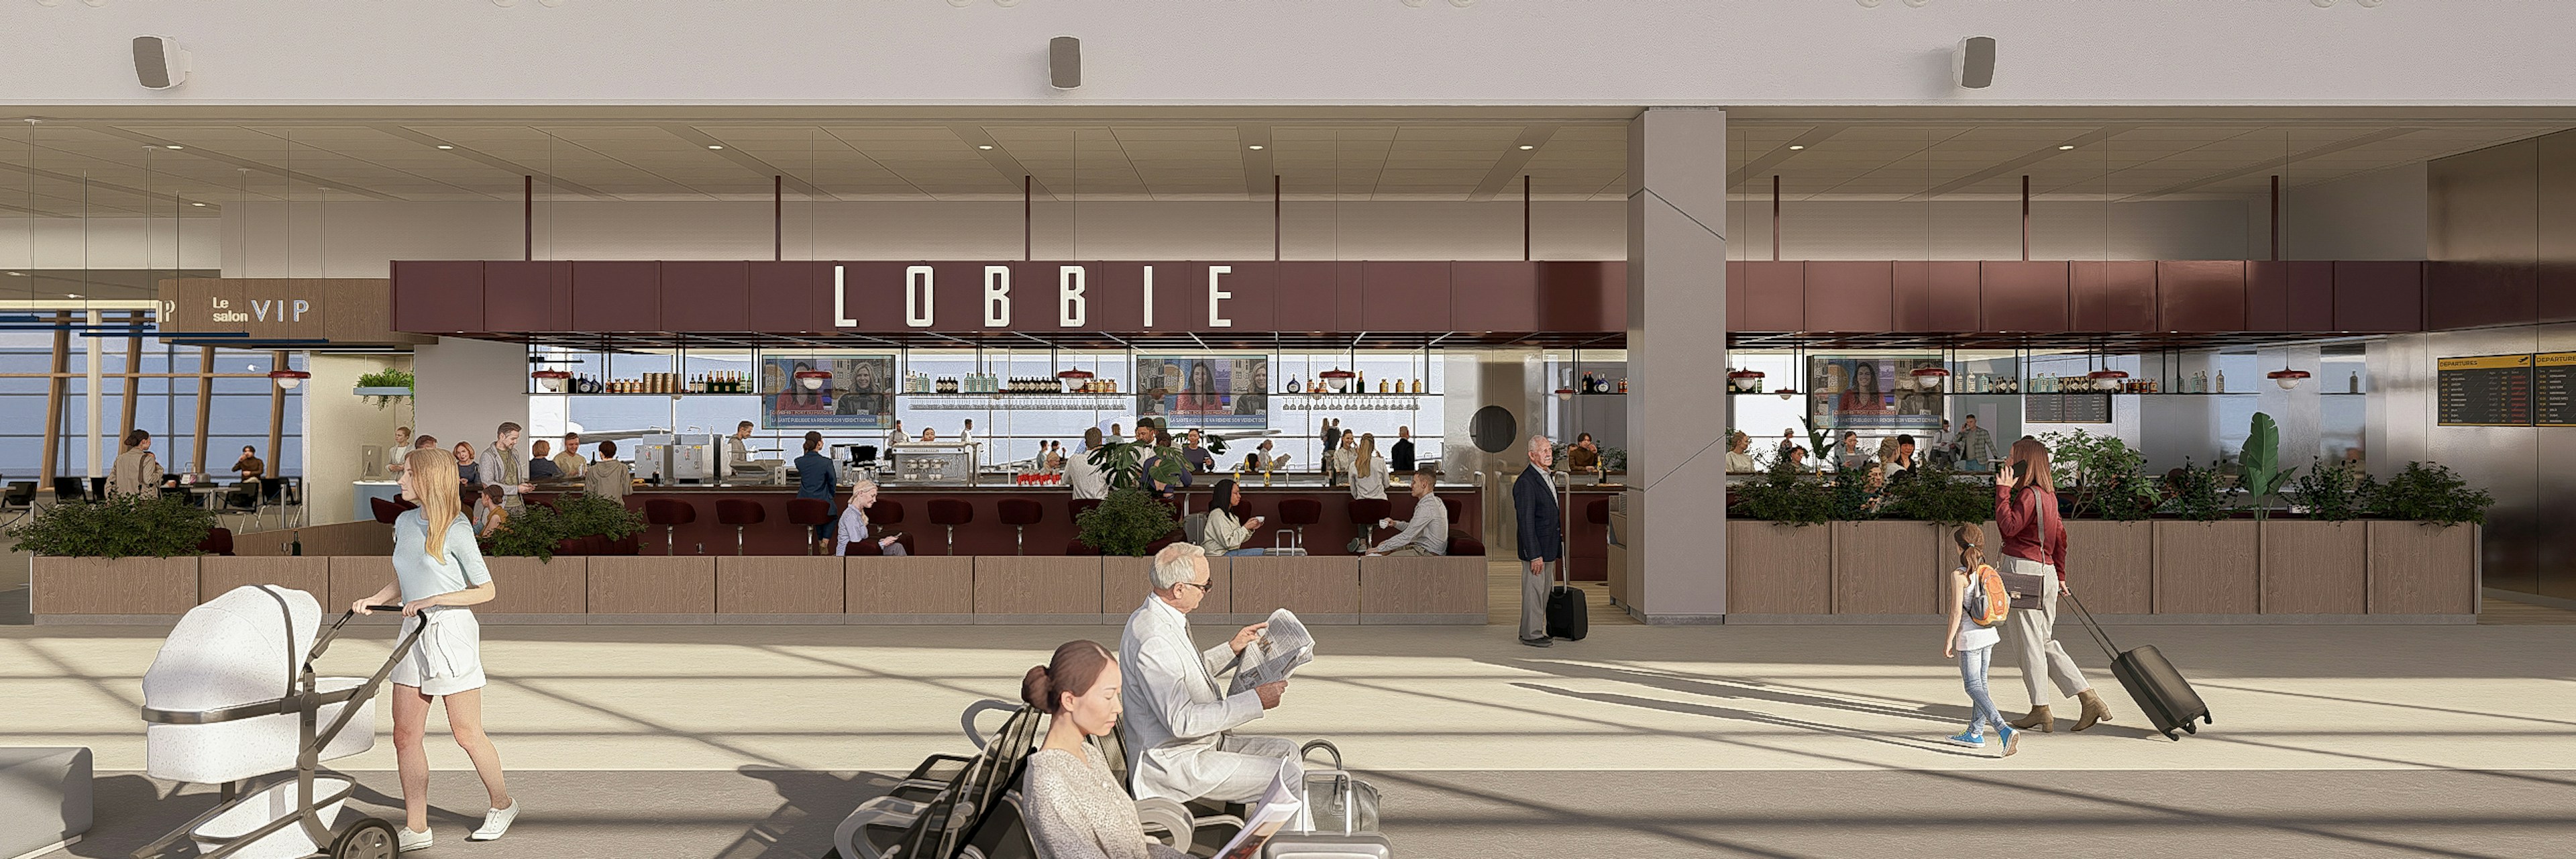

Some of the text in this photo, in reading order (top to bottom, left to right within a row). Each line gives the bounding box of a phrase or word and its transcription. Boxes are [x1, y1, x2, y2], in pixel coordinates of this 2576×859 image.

[213, 297, 229, 309] Le
[834, 265, 1232, 327] LOBBIE
[213, 309, 248, 322] salon
[250, 299, 309, 322] VIP
